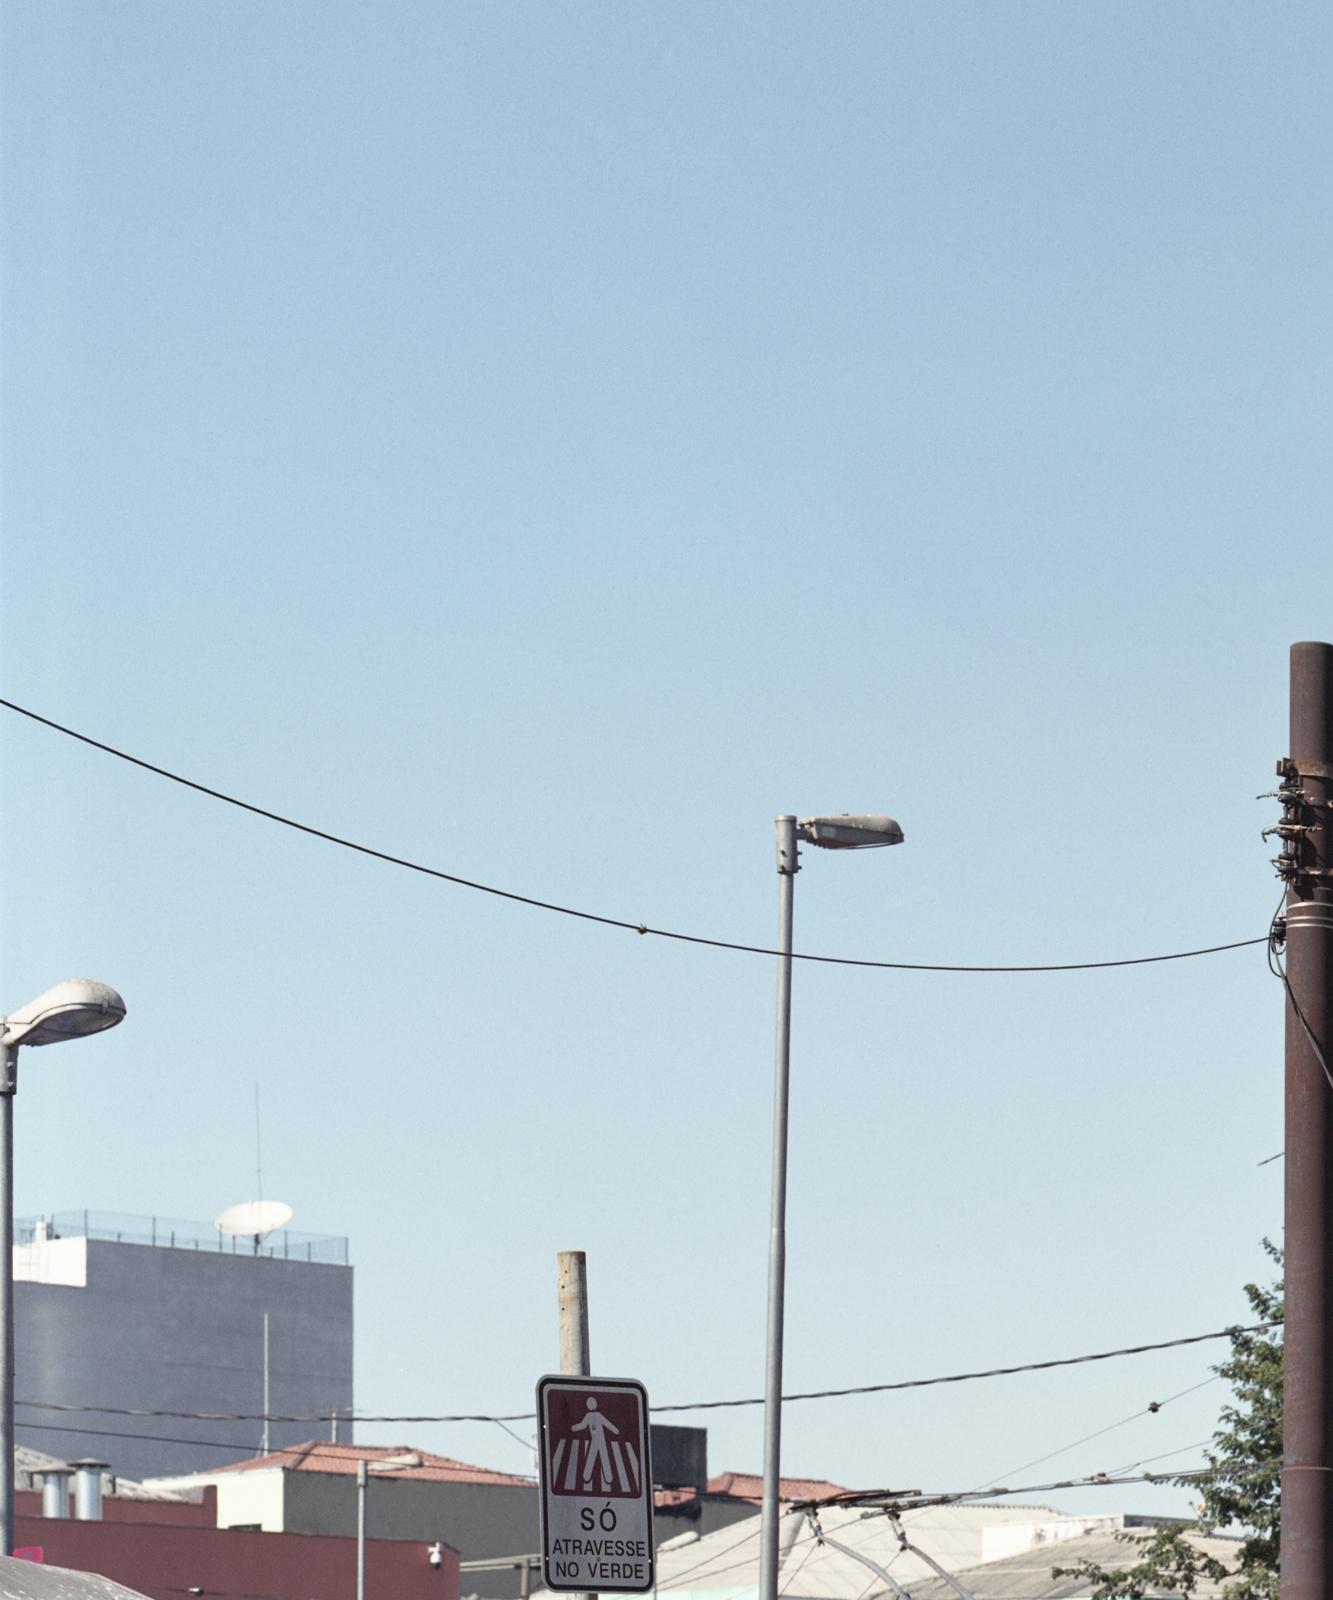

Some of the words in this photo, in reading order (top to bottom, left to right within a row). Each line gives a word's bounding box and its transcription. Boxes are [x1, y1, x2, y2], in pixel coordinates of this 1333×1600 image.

[580, 1501, 617, 1532] SÓ
[552, 1539, 646, 1557] ATRAVESSE
[556, 1562, 579, 1578] NO
[588, 1562, 644, 1579] VERDE
